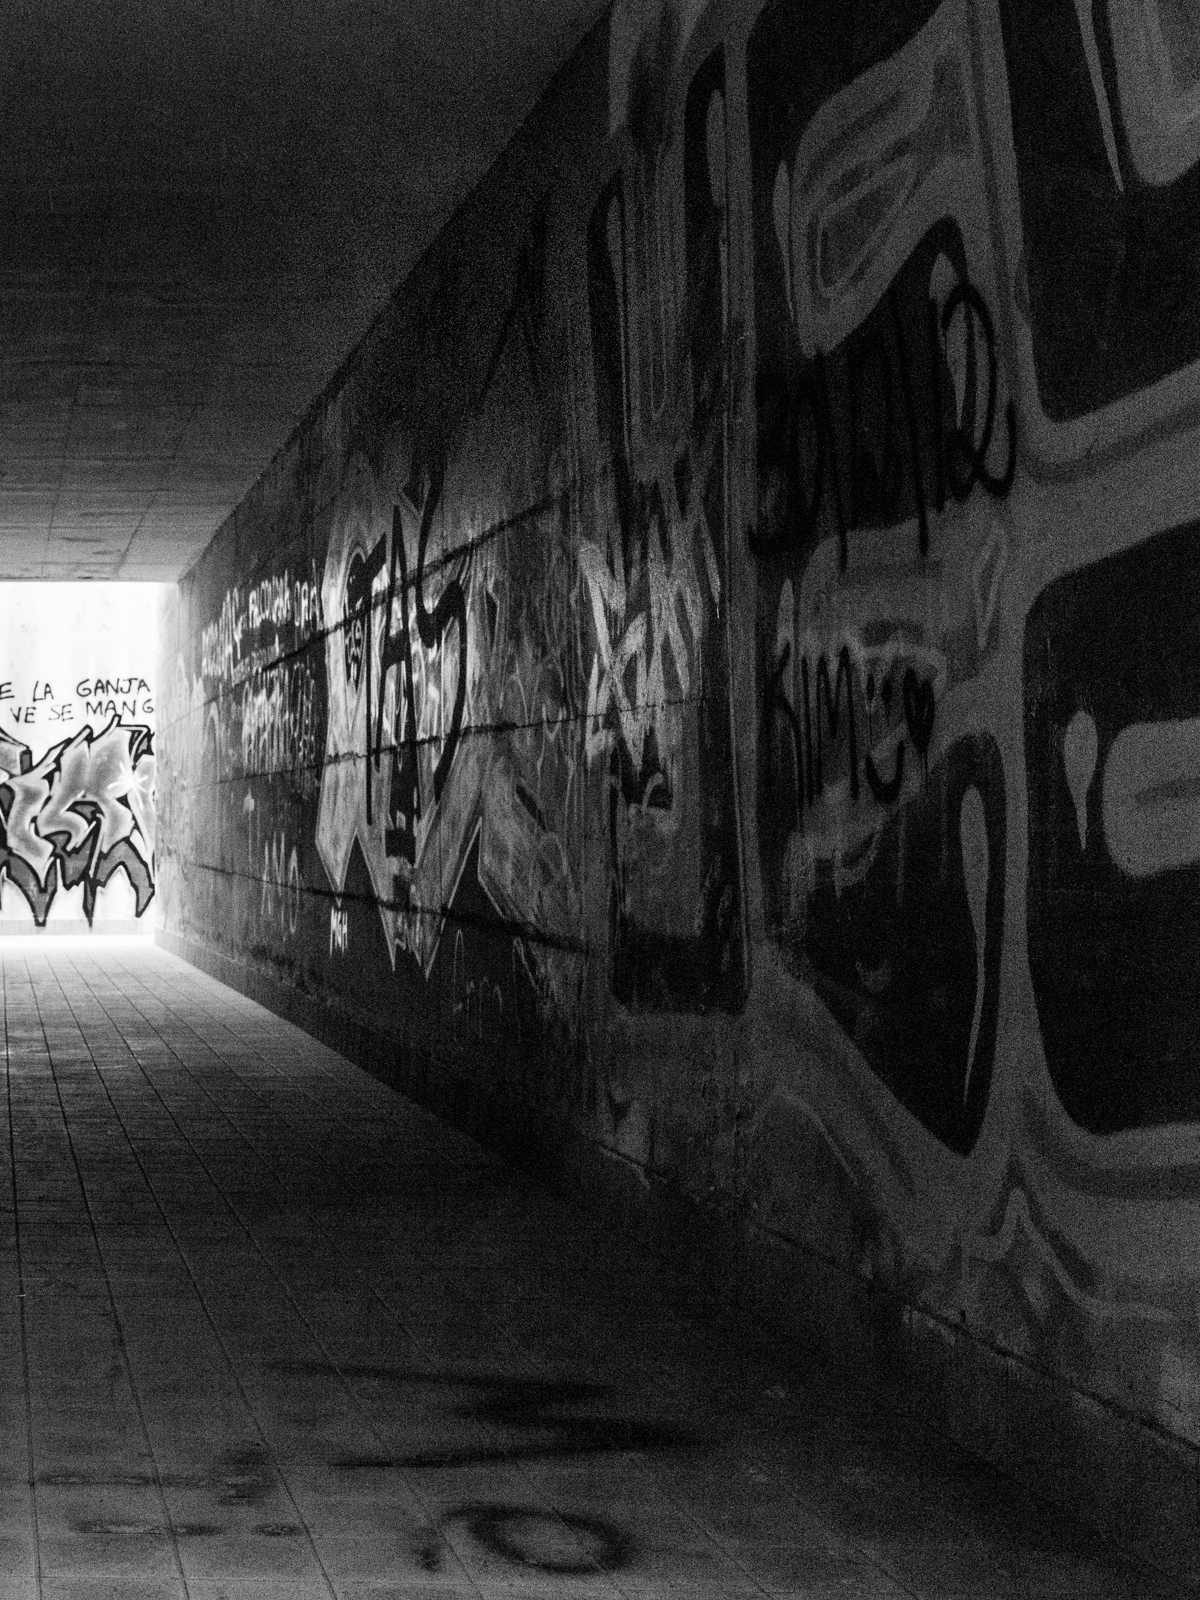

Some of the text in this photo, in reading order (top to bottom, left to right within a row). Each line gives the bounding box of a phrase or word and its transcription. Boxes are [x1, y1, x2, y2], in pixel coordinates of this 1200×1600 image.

[32, 680, 54, 702] LA
[76, 677, 150, 697] GANJA
[10, 706, 37, 724] VE
[48, 703, 74, 721] SE
[86, 699, 154, 717] MANG
